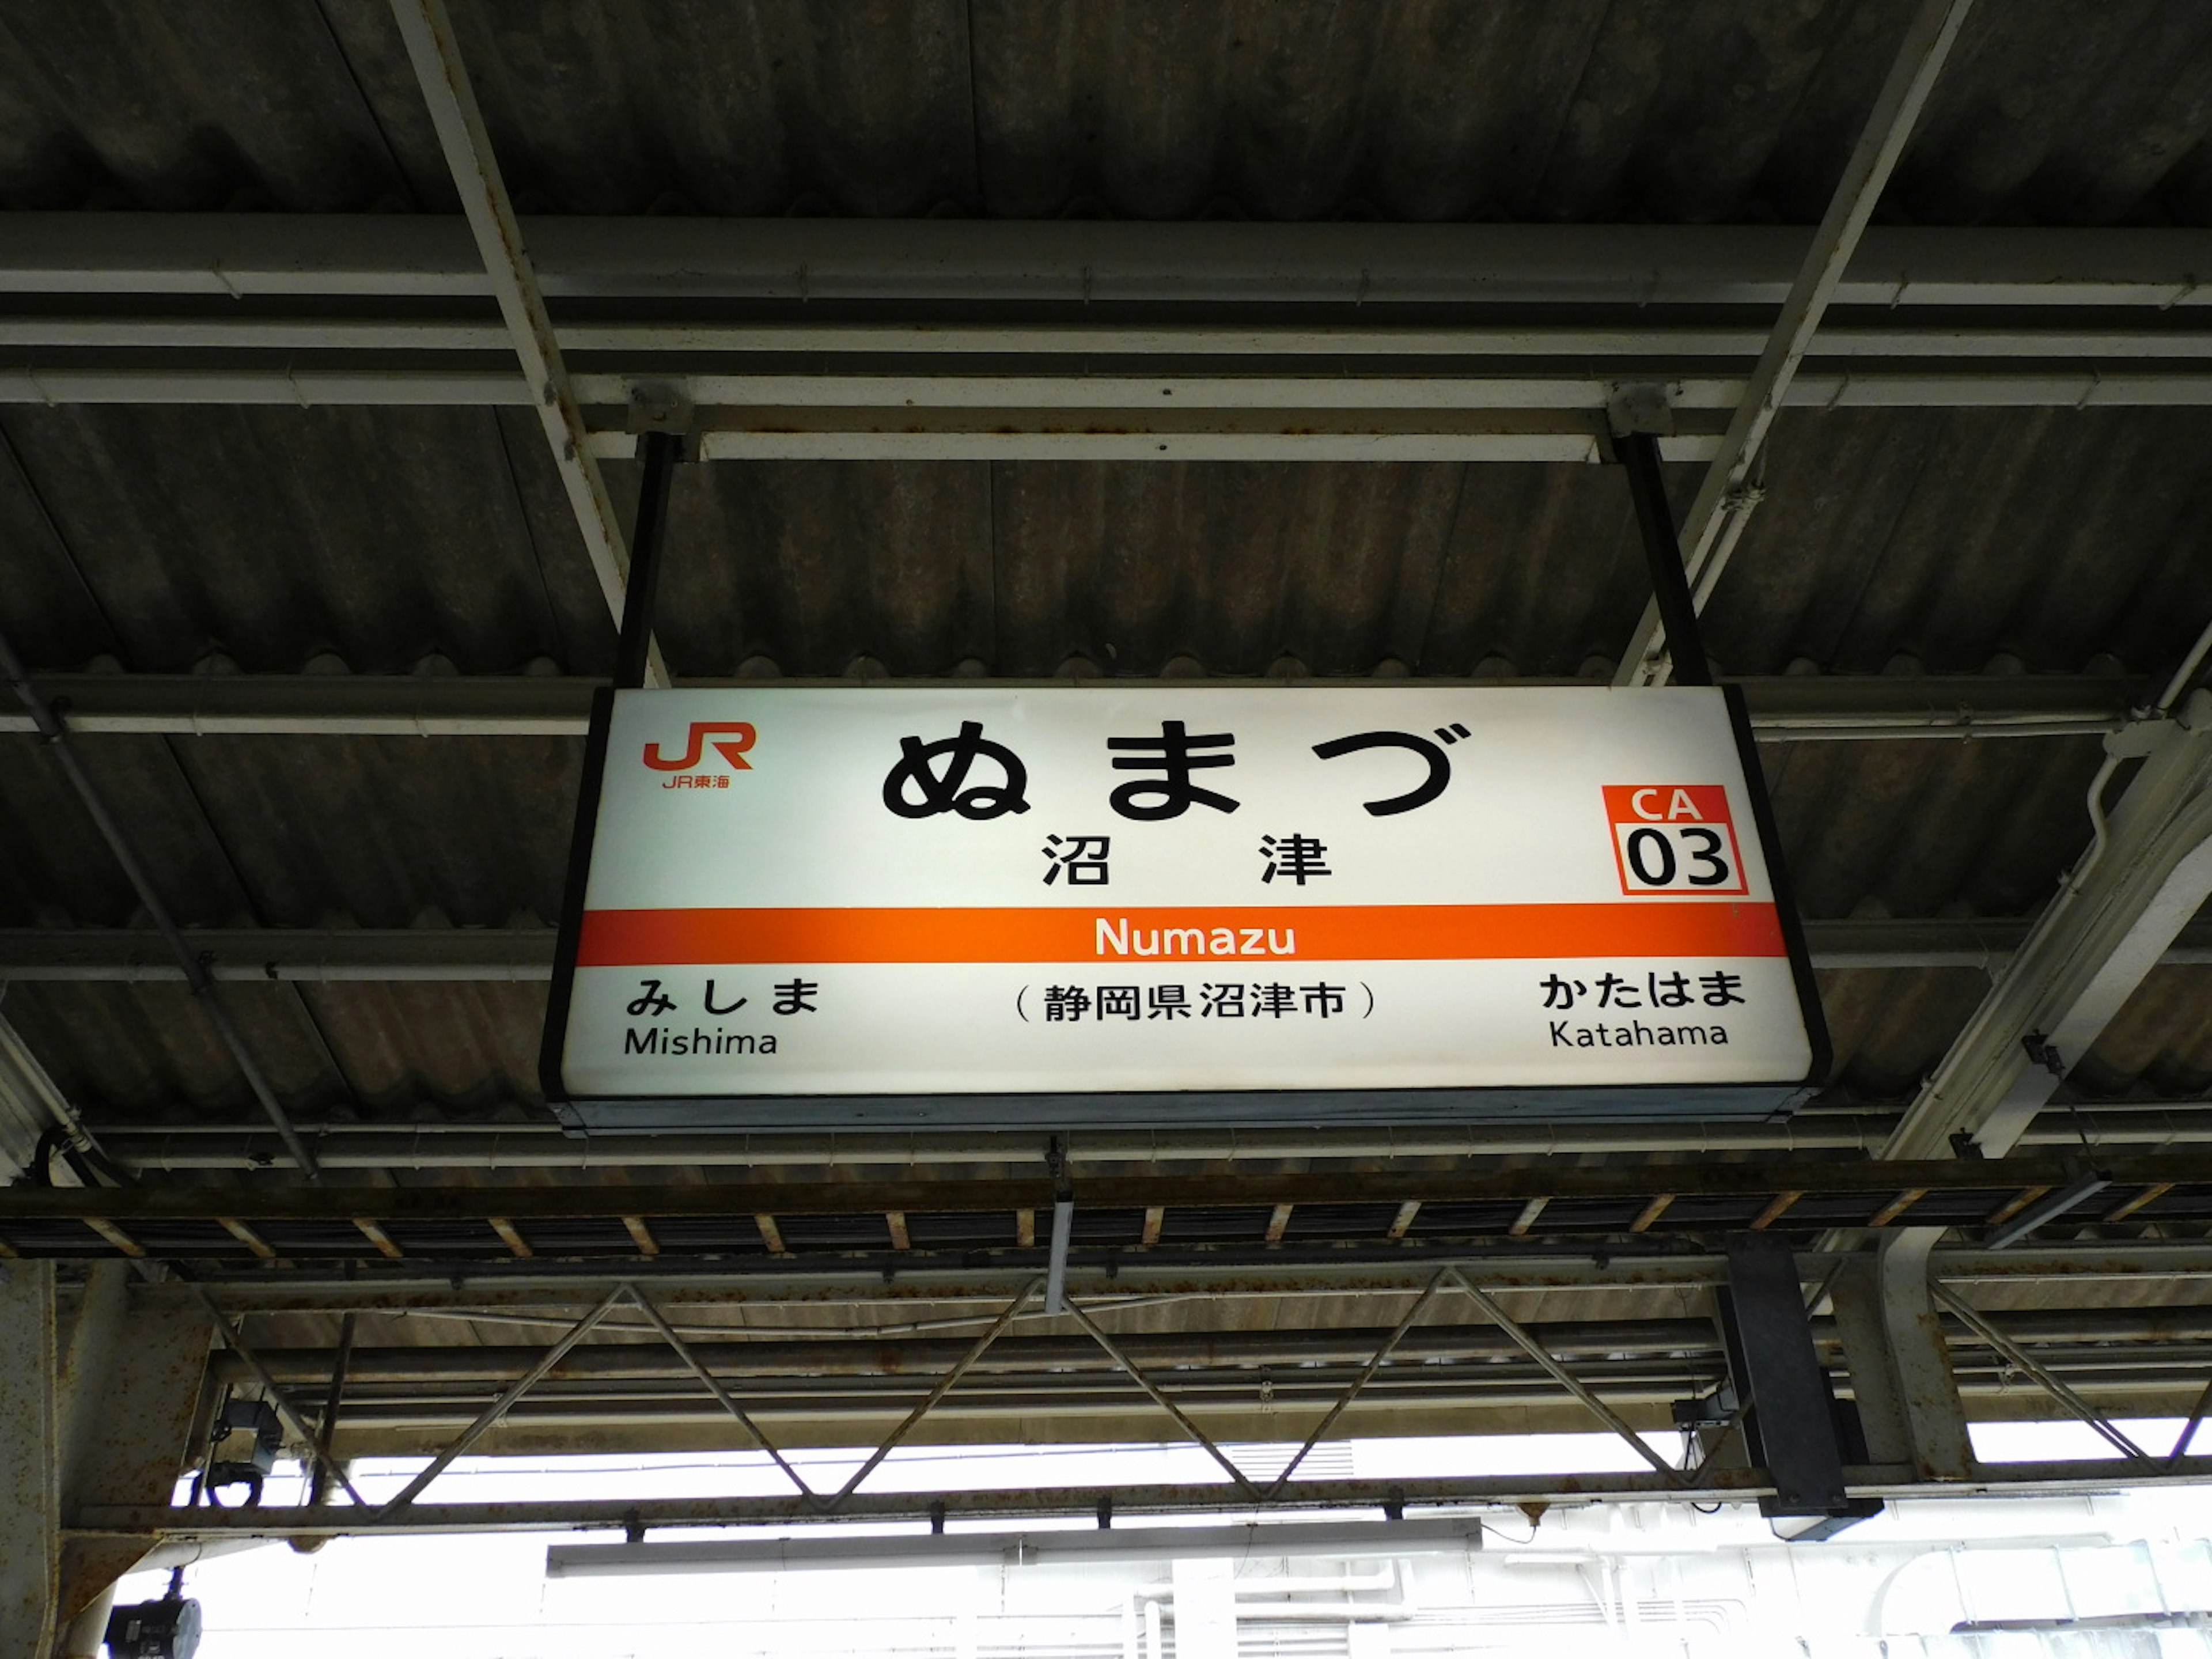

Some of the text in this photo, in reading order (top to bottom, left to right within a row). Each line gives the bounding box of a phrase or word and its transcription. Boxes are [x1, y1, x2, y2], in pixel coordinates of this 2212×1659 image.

[643, 722, 756, 771] JR
[662, 775, 730, 789] JR東海
[883, 721, 1471, 821] ぬまづ
[1631, 789, 1703, 820] CA
[1041, 834, 1332, 885] 沼津
[1627, 828, 1729, 886] 03
[1095, 918, 1296, 956] Numazu
[626, 979, 818, 1017] みしま
[1540, 971, 1746, 1009] かたはま
[624, 1028, 777, 1055] Mishima
[1550, 1020, 1729, 1047] Katahama
